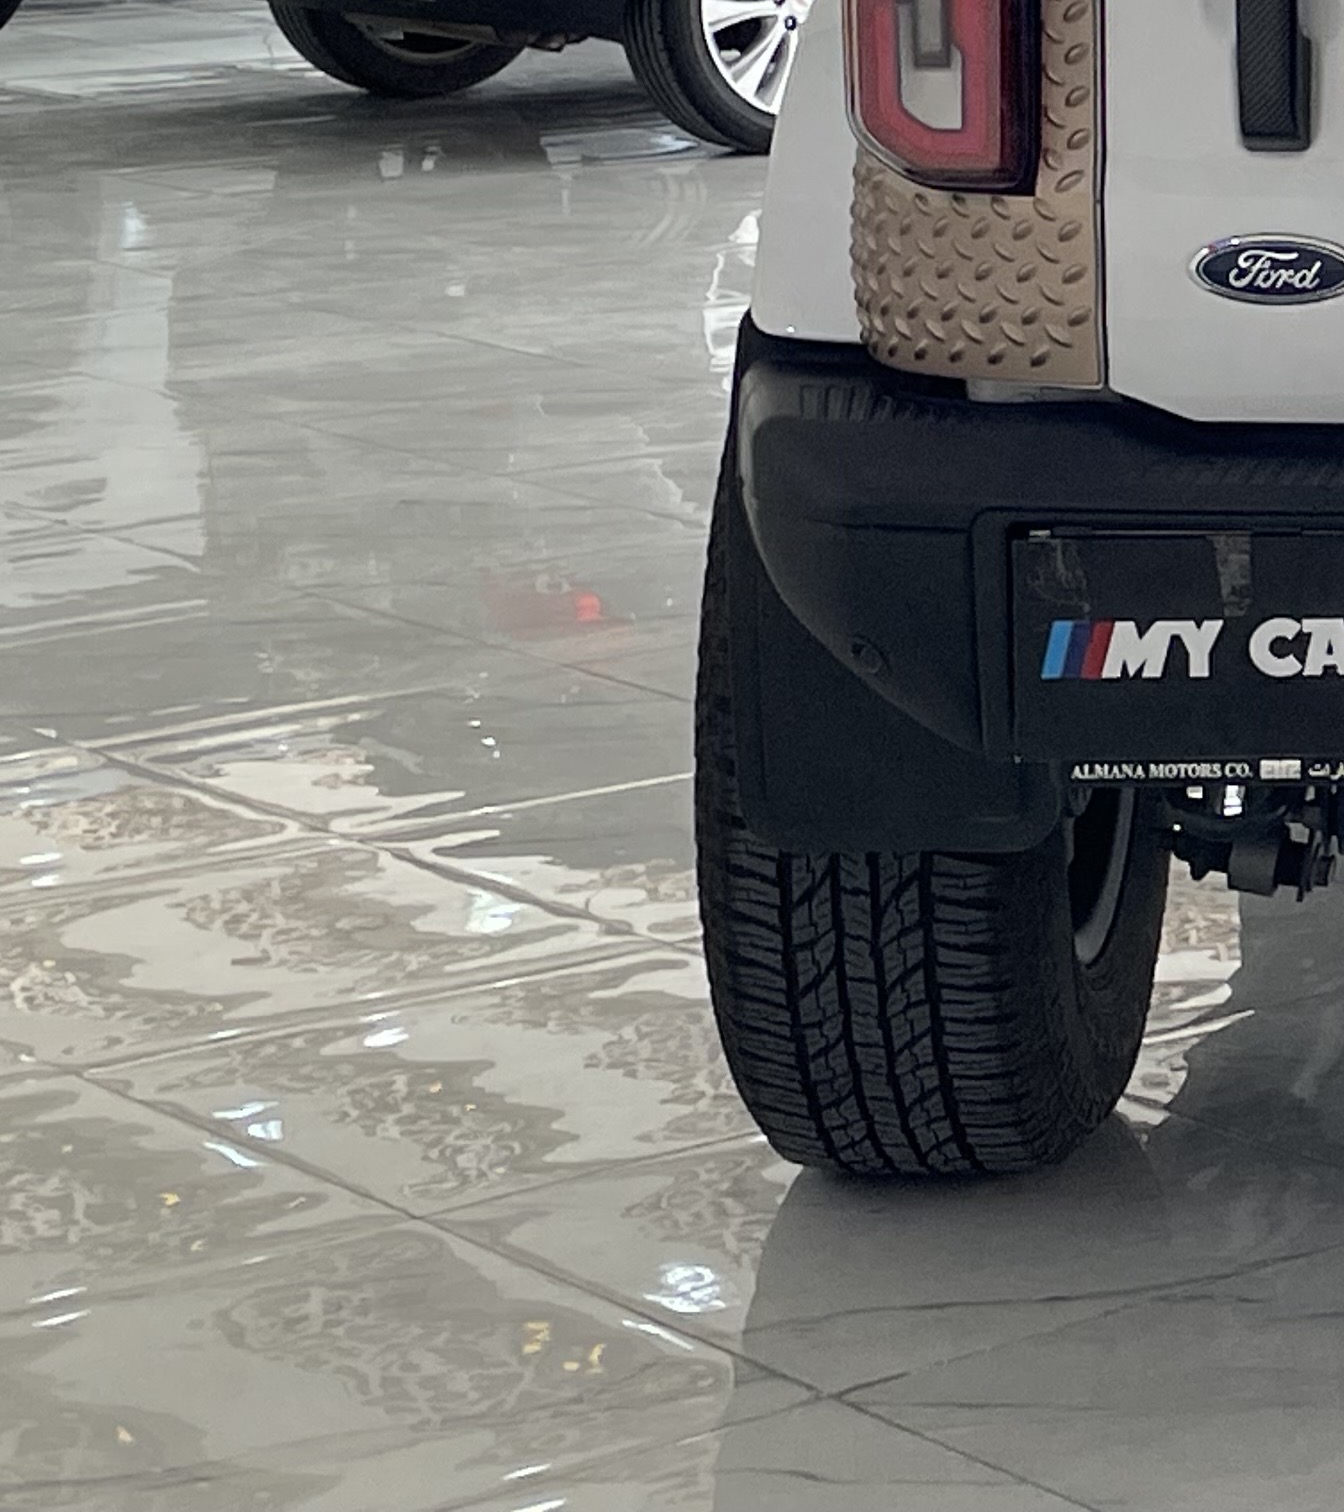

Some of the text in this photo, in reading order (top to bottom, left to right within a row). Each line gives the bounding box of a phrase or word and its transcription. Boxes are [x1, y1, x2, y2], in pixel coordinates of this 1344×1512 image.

[1229, 249, 1323, 290] Ford
[1101, 619, 1224, 679] MY
[1071, 763, 1146, 780] ALMANA
[1148, 762, 1222, 779] MOTORS
[1225, 762, 1253, 778] CO.
